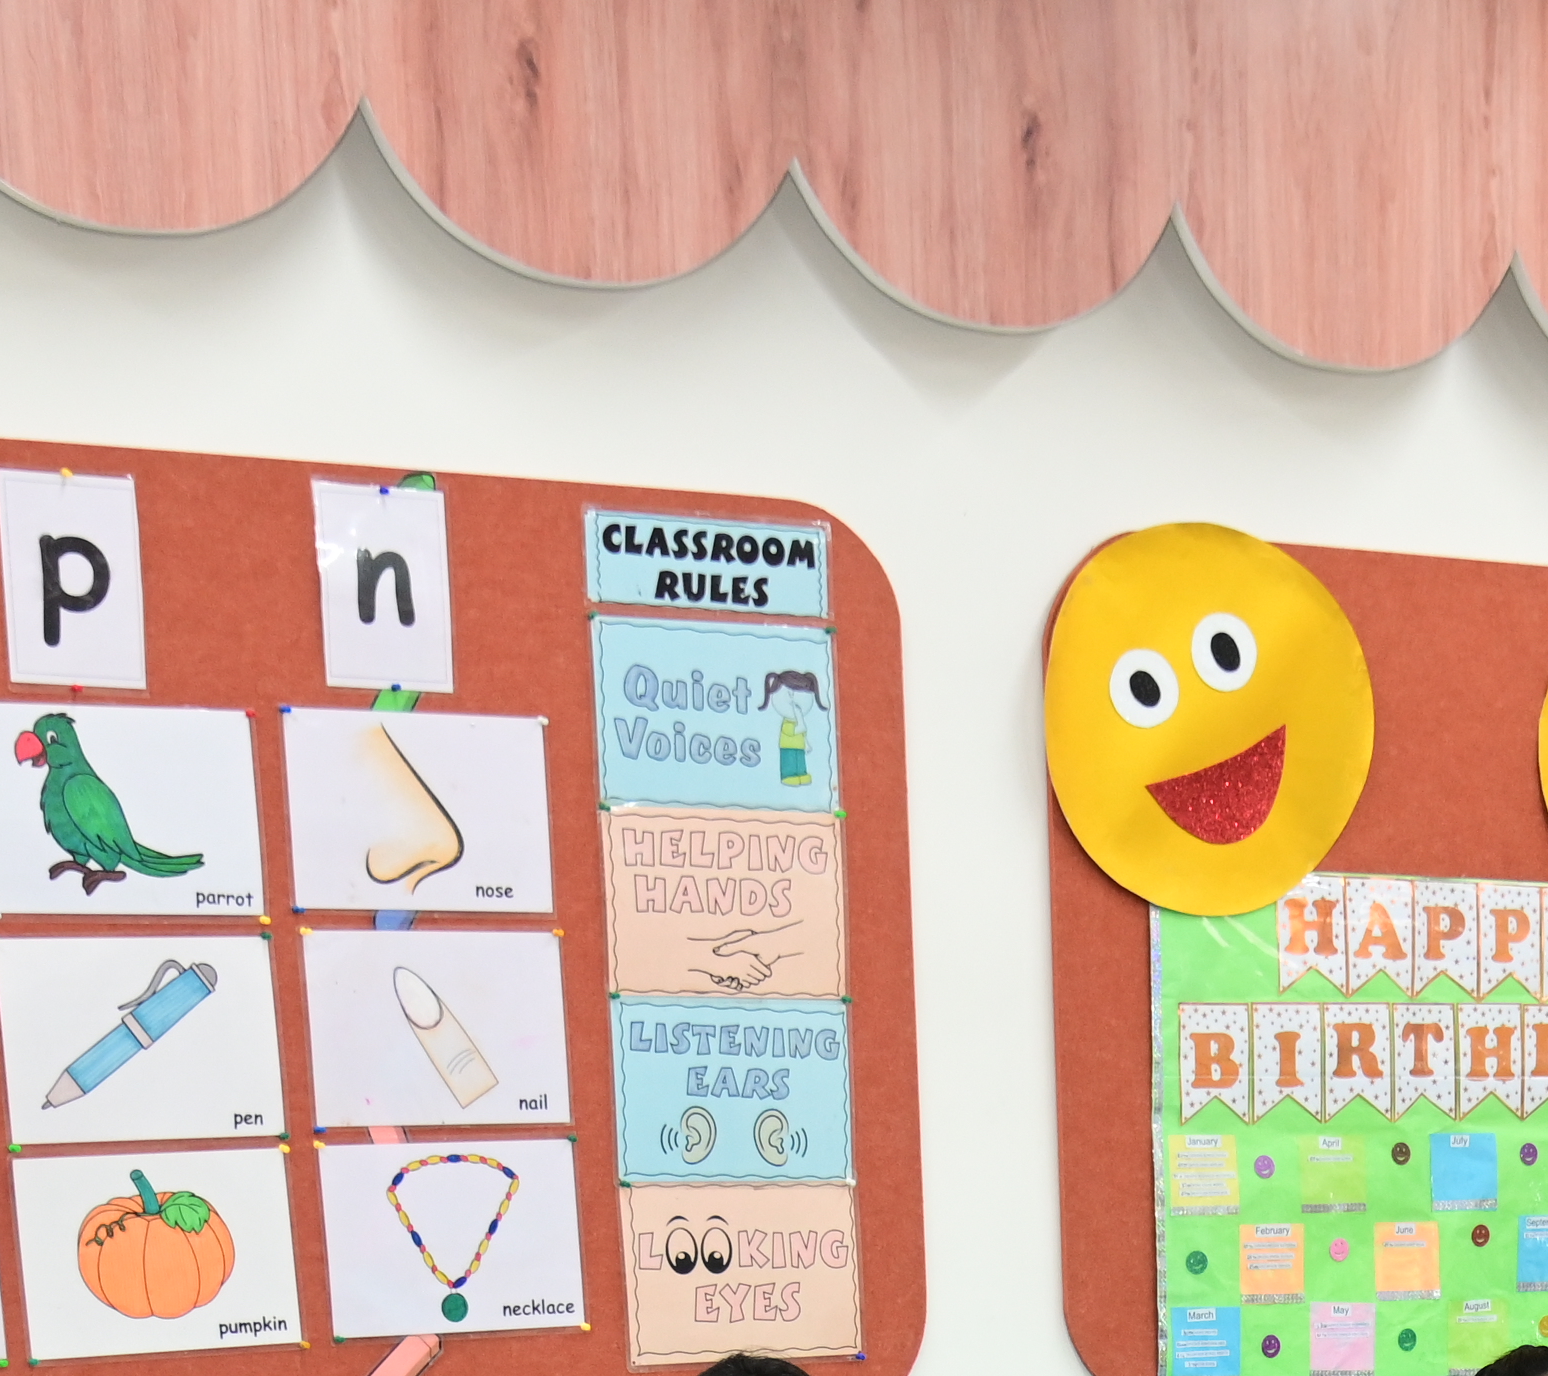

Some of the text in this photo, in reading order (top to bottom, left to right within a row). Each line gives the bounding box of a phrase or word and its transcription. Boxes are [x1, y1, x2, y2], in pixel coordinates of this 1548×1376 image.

[602, 523, 816, 569] CLASSROOM
[38, 534, 111, 647] p
[356, 547, 416, 627] n
[655, 570, 769, 607] RULES
[623, 663, 752, 715] Quiet
[613, 717, 762, 767] Voices
[621, 828, 830, 875] HELPING
[195, 889, 254, 909] parrot
[475, 884, 514, 899] nose
[633, 874, 792, 918] HANDS
[628, 1020, 841, 1061] LISTENING
[686, 1066, 790, 1100] EARS
[518, 1093, 549, 1112] nail
[233, 1111, 264, 1130] pen
[1187, 1137, 1219, 1148] January
[1322, 1138, 1340, 1149] April
[1451, 1135, 1468, 1147] July
[1255, 1225, 1290, 1237] February
[1395, 1226, 1414, 1234] June
[638, 1227, 849, 1275] LOOKING
[502, 1299, 576, 1318] necklace
[693, 1281, 801, 1324] EYES
[1333, 1305, 1350, 1317] May
[1464, 1300, 1490, 1313] August
[1188, 1310, 1214, 1320] March
[218, 1316, 288, 1339] pumpkin
